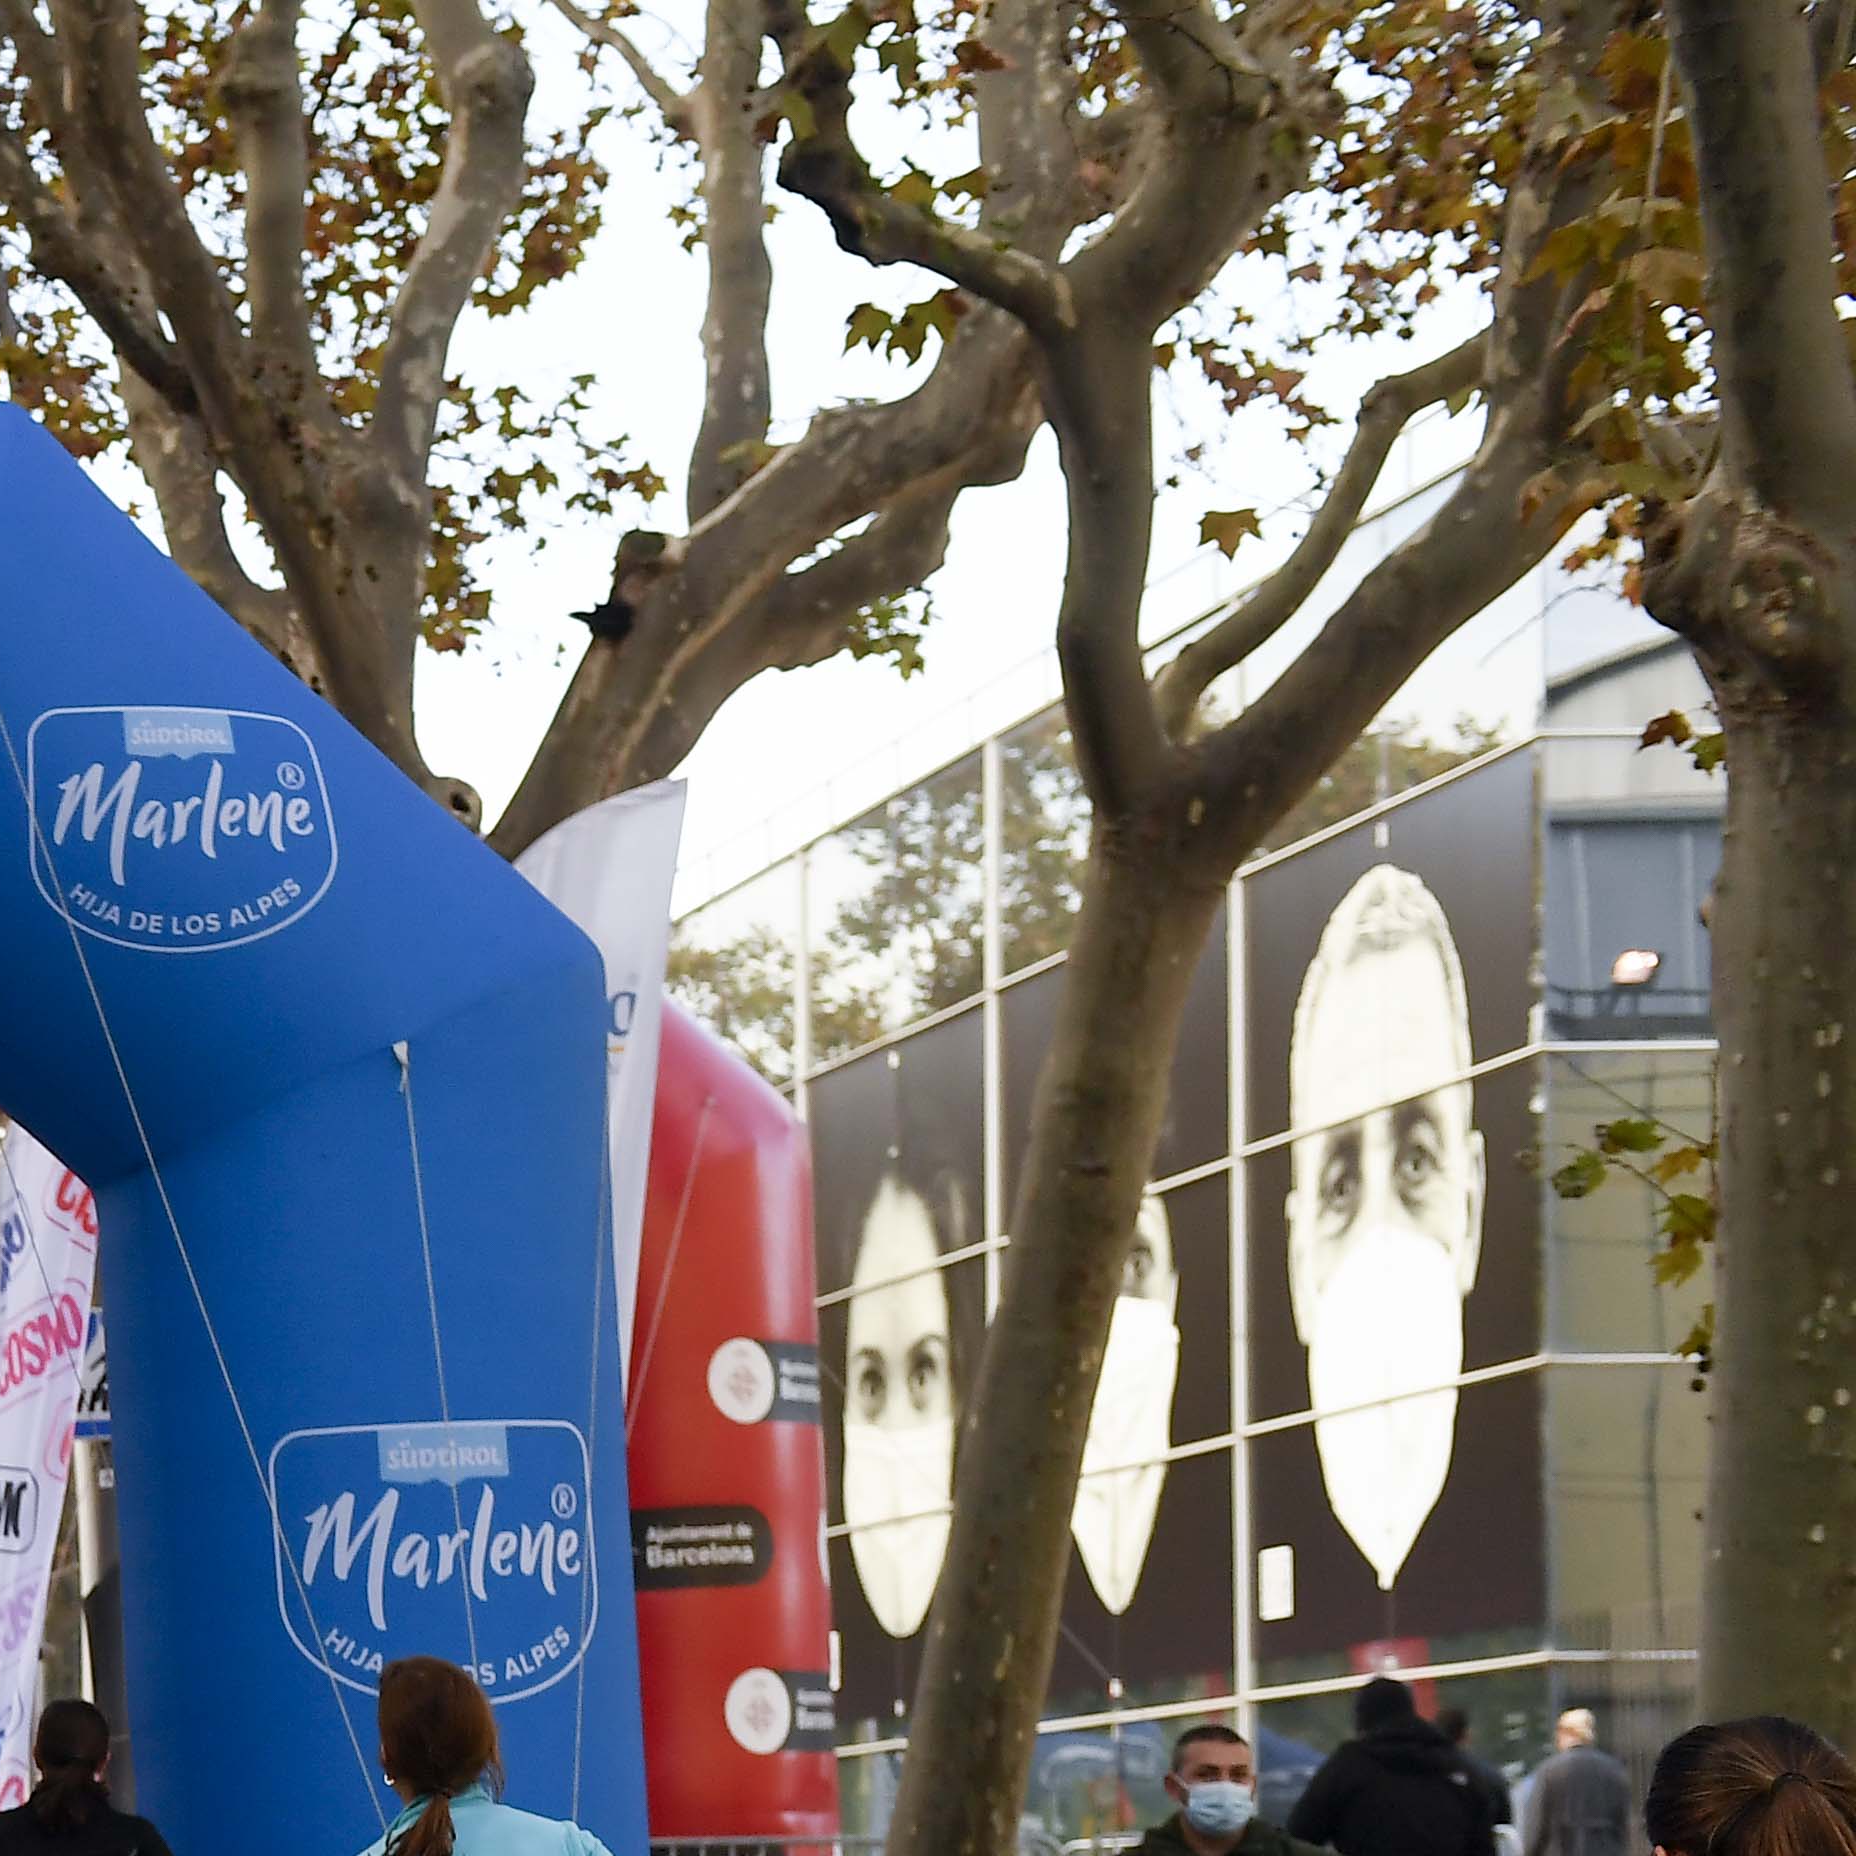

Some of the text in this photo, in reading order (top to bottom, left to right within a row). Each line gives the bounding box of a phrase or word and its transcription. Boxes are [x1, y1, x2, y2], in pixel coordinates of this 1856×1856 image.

[68, 877, 302, 936] HIJA DE LOS ALPES
[645, 1542, 755, 1569] Barcelona
[324, 1627, 383, 1675] HIJA
[504, 1624, 571, 1682] ALPES
